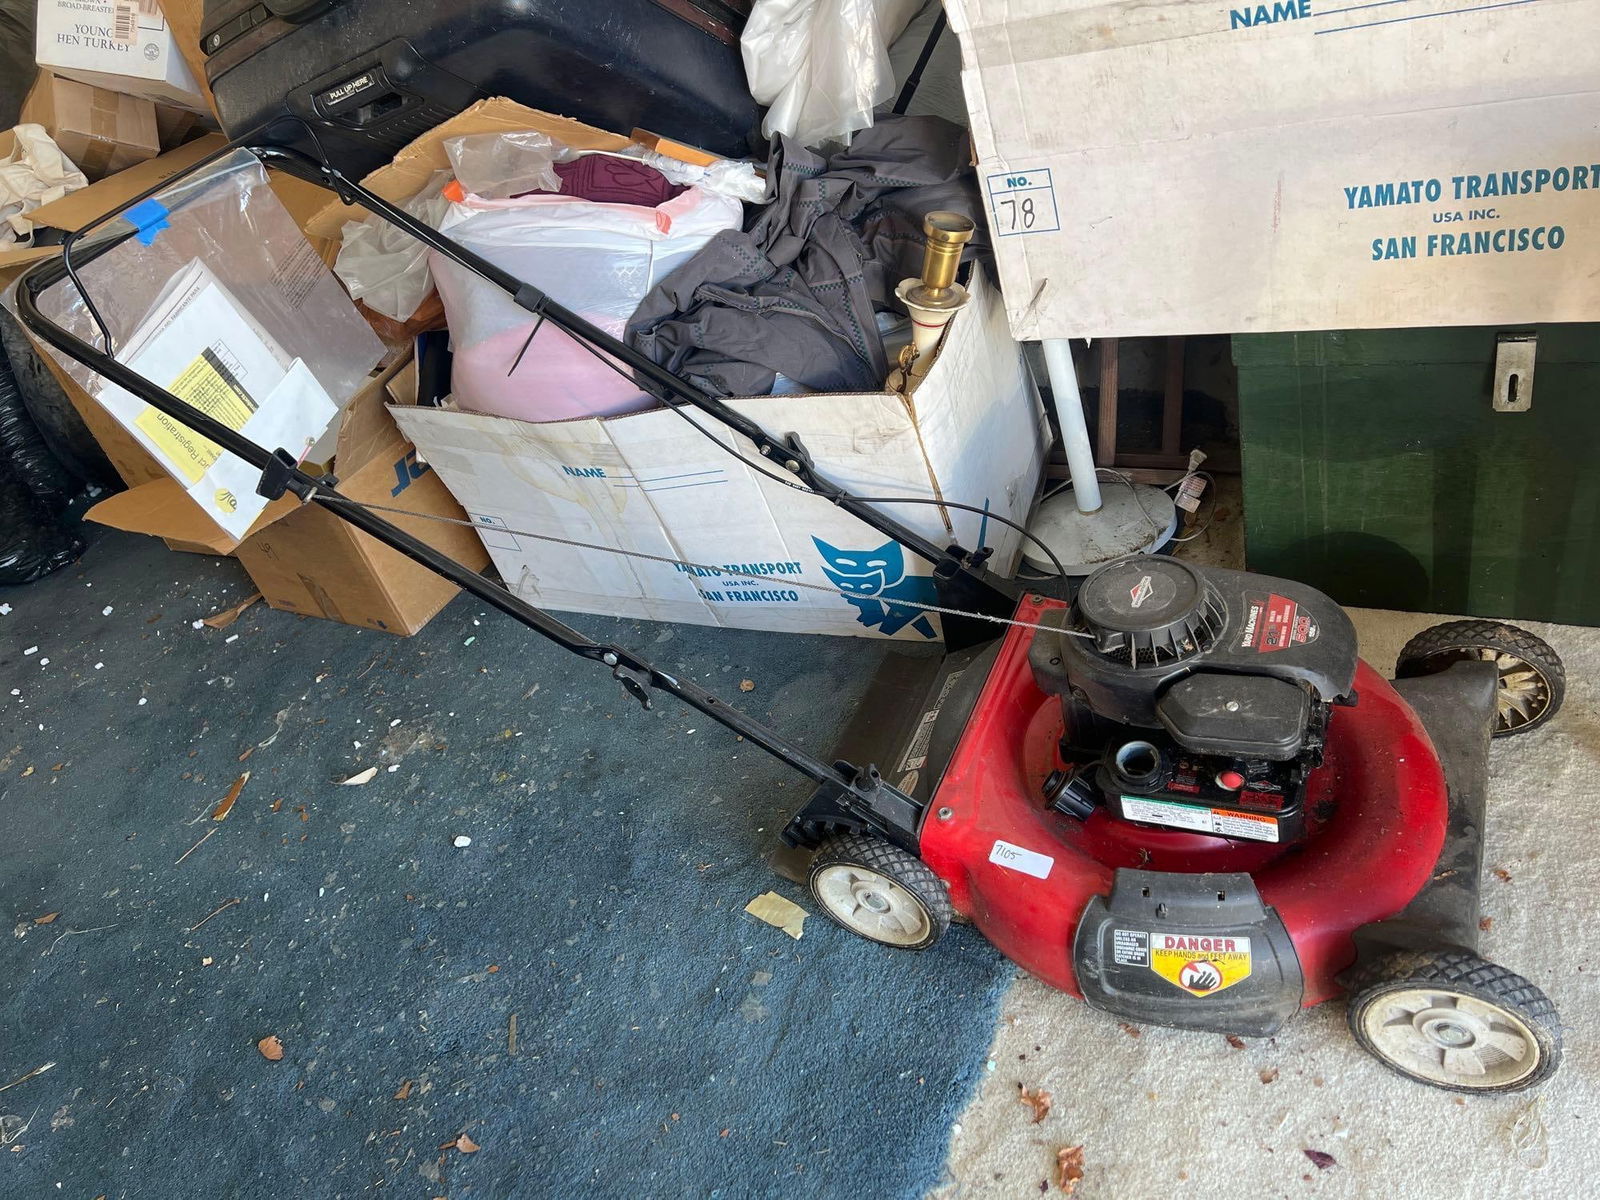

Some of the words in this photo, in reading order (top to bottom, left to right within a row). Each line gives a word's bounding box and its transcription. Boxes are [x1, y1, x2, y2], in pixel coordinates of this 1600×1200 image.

[1230, 0, 1311, 30] NAME
[57, 32, 80, 45] HEN
[329, 89, 345, 100] PULL
[1006, 176, 1033, 188] NO.
[1343, 178, 1442, 210] YAMATO
[1452, 164, 1600, 200] TRANSPORT
[1000, 198, 1035, 230] 78
[1432, 211, 1464, 223] USA
[1468, 208, 1500, 220] INC.
[1371, 236, 1417, 261] SAN
[1427, 225, 1565, 257] FRANCISCO
[156, 413, 199, 461] Registration
[561, 465, 607, 478] NAME
[722, 562, 803, 576] TRANSPORT
[725, 590, 799, 602] FRANCISCO
[1227, 811, 1266, 823] WARNING
[1165, 936, 1236, 952] DANGER
[1174, 950, 1197, 959] HANDS
[1211, 952, 1227, 960] FEET
[1228, 953, 1247, 961] AWAY
